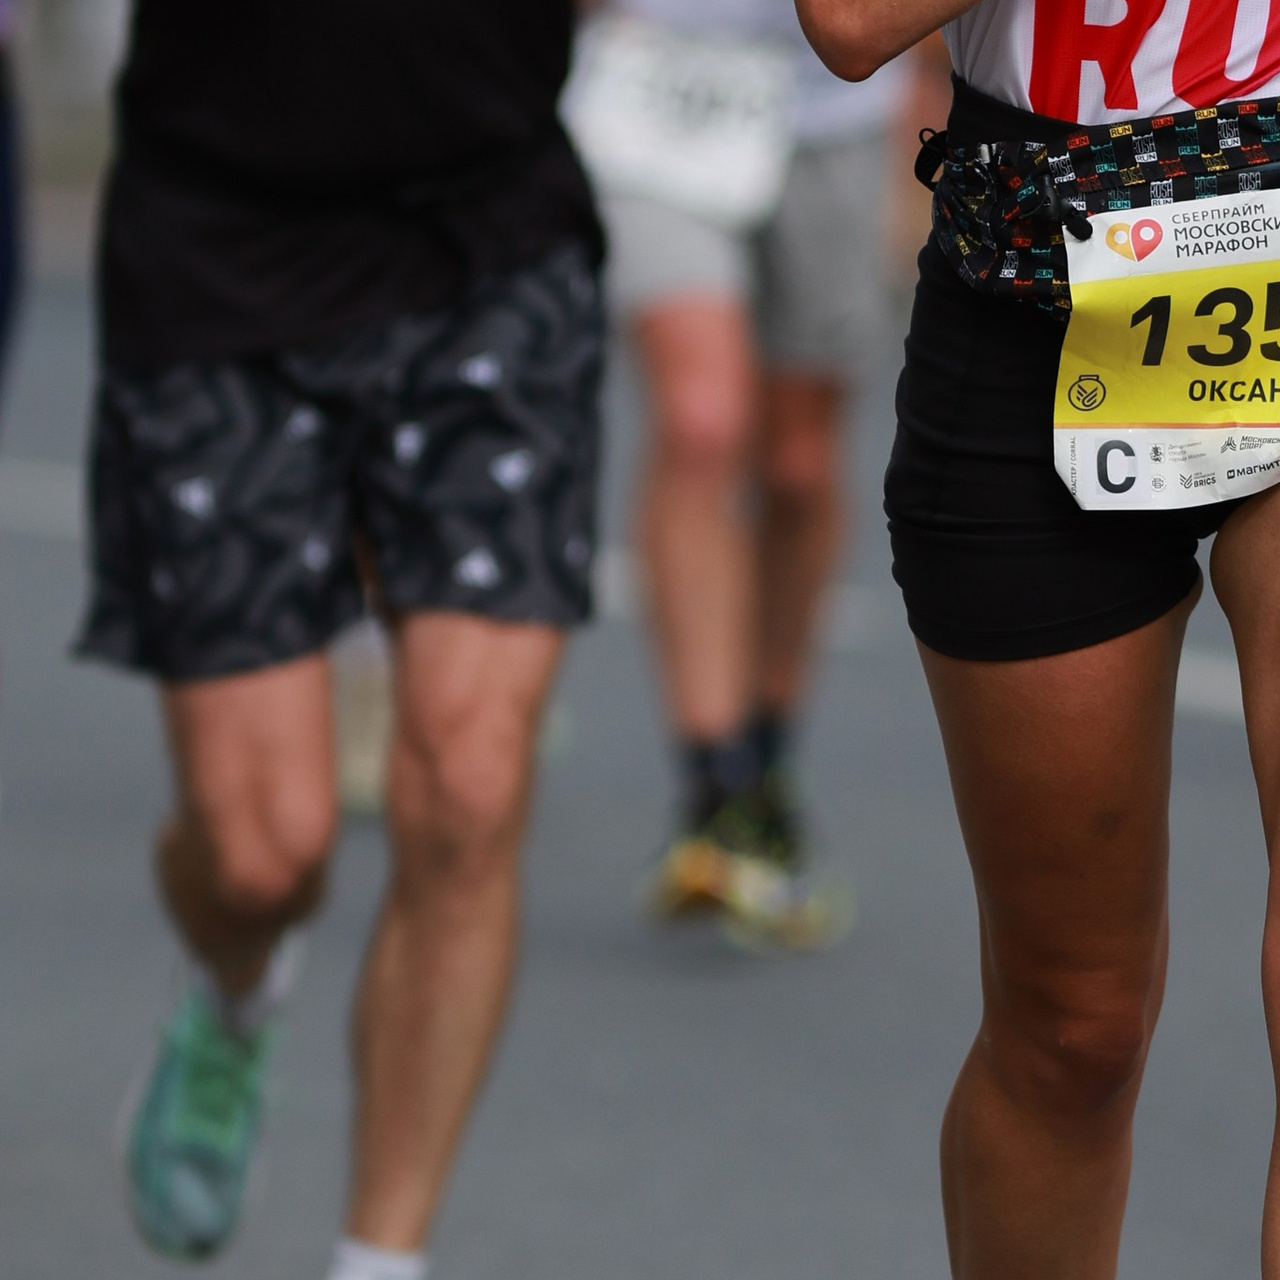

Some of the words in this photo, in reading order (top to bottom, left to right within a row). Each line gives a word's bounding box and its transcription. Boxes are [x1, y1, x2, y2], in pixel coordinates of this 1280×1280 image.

[1195, 108, 1217, 120] RUN
[1238, 104, 1258, 114] RUN
[1152, 117, 1174, 129] RUN
[1110, 125, 1133, 138] RUN
[1218, 122, 1240, 138] ROSA
[1067, 136, 1089, 149] RUN
[1133, 137, 1155, 156] ROSA
[1219, 137, 1241, 148] RUN
[1178, 145, 1199, 155] RUN
[1135, 152, 1157, 163] RUN
[1096, 163, 1118, 173] RUN
[1239, 172, 1261, 190] ROSA
[1150, 183, 1173, 199] ROSA
[1109, 200, 1131, 210] RUN
[1172, 204, 1265, 225] СБЕРПРАЙМ
[1176, 235, 1269, 258] МАРАФОН
[1035, 269, 1053, 278] RUN
[1239, 442, 1263, 451] СПОРТ
[1096, 439, 1137, 494] C
[1193, 476, 1217, 488] BRICS
